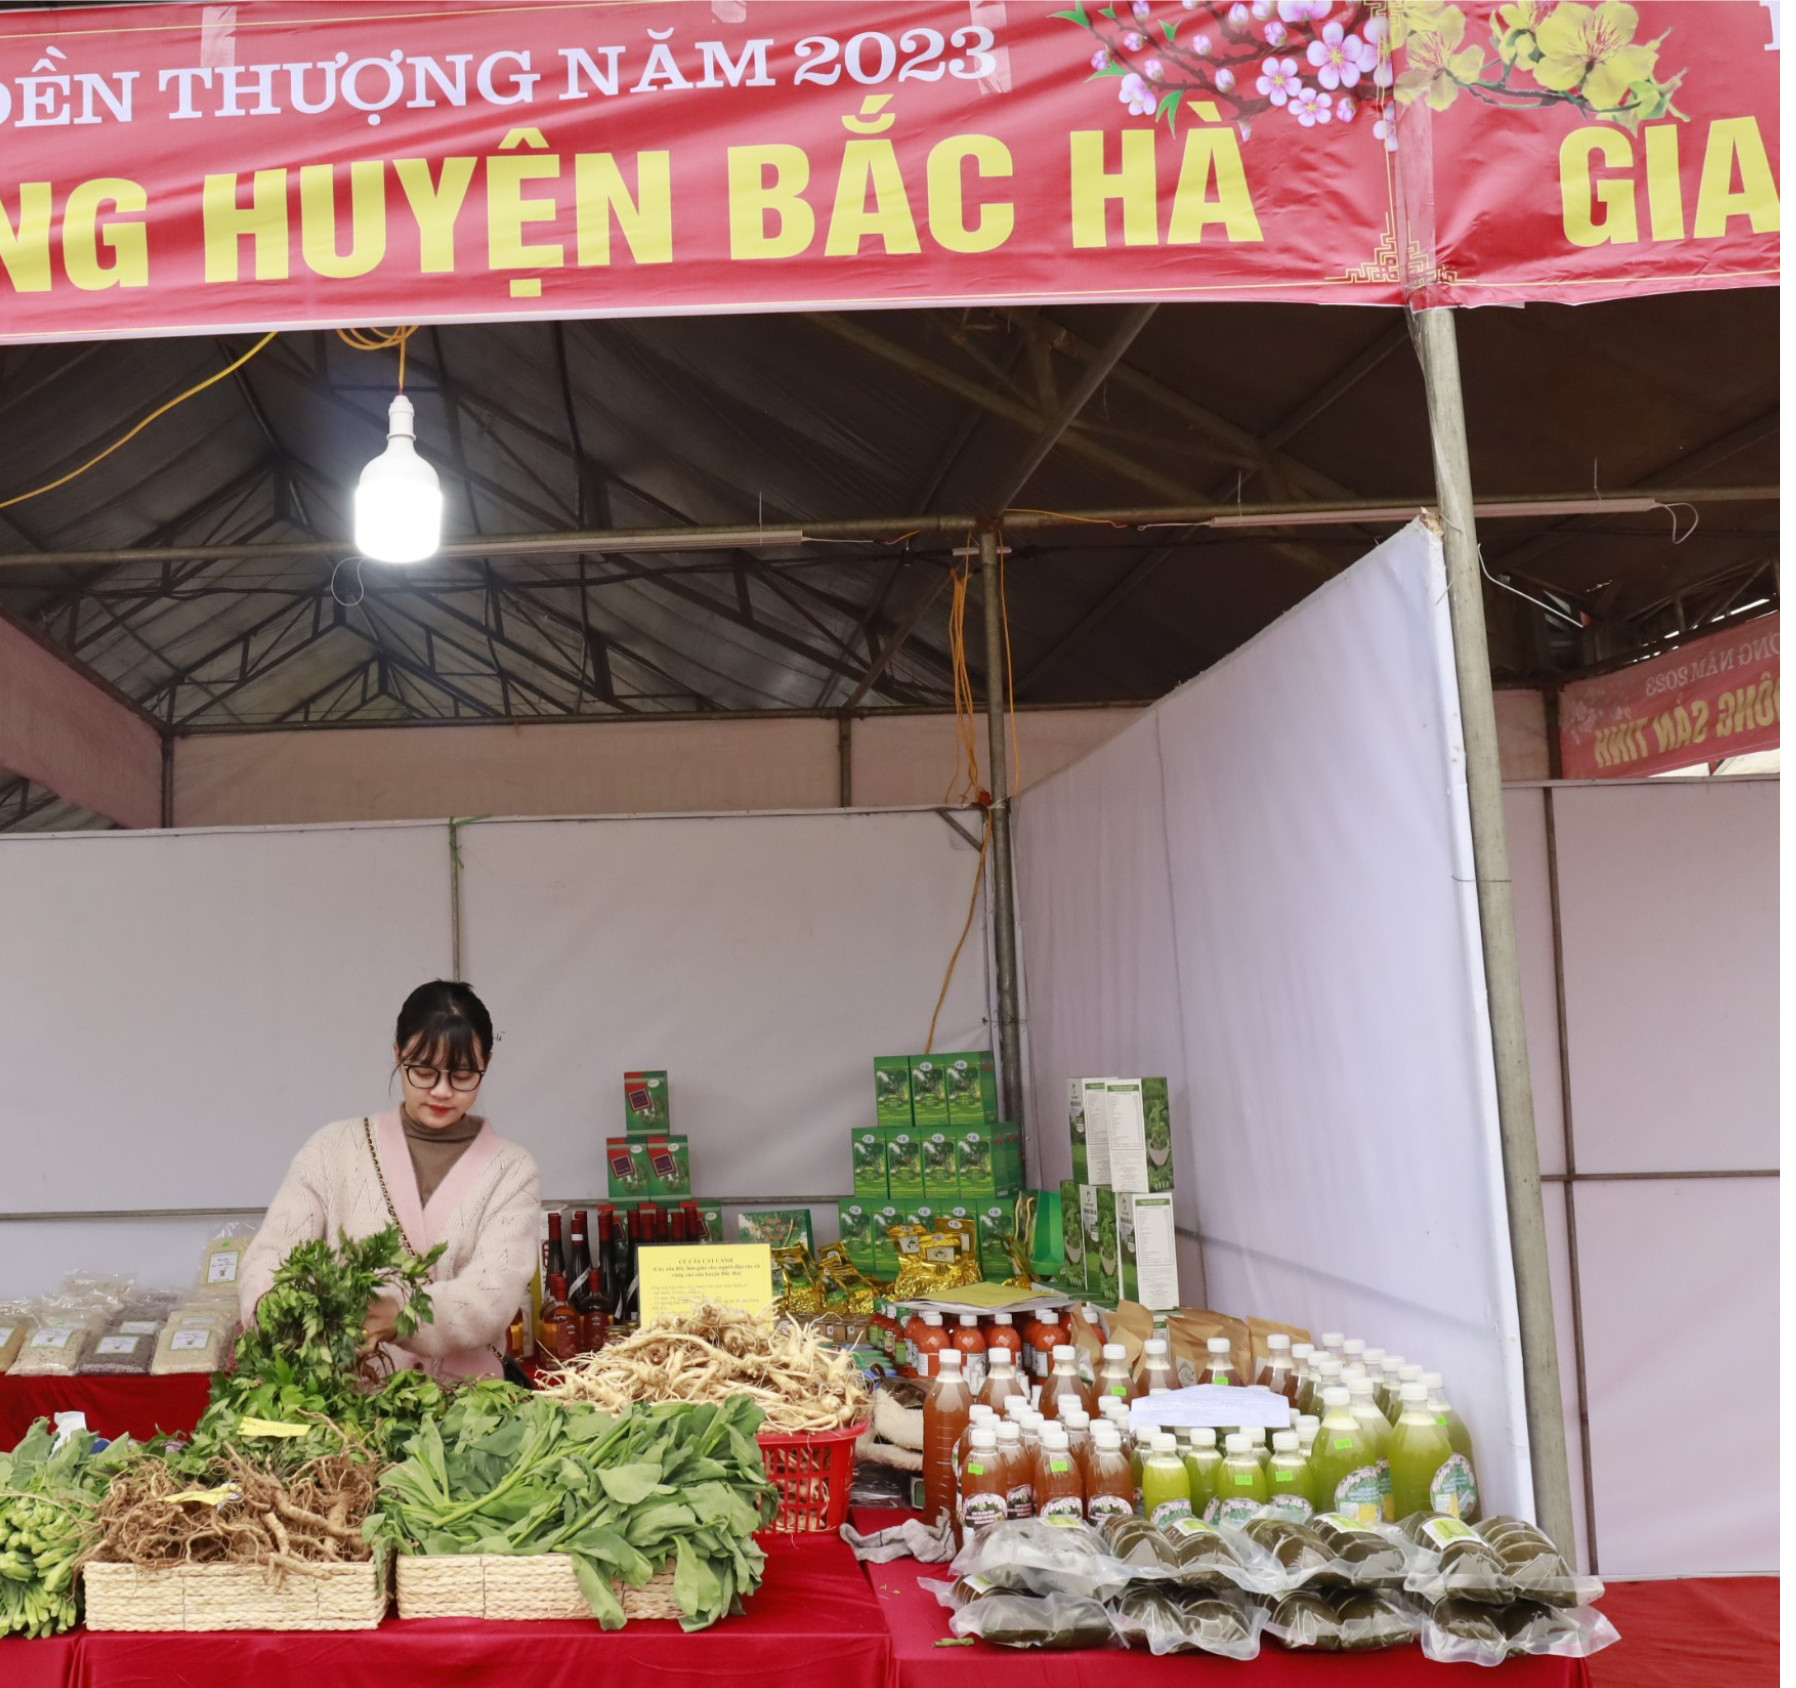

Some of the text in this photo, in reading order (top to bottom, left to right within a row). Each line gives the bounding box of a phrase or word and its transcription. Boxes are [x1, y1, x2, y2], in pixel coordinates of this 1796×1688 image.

[157, 40, 536, 128] THƯỢNG
[555, 28, 778, 101] NĂM
[793, 25, 998, 85] 2023
[201, 126, 676, 298] HUYỆN
[726, 95, 1016, 261] BẮC
[1069, 100, 1265, 251] HÀ
